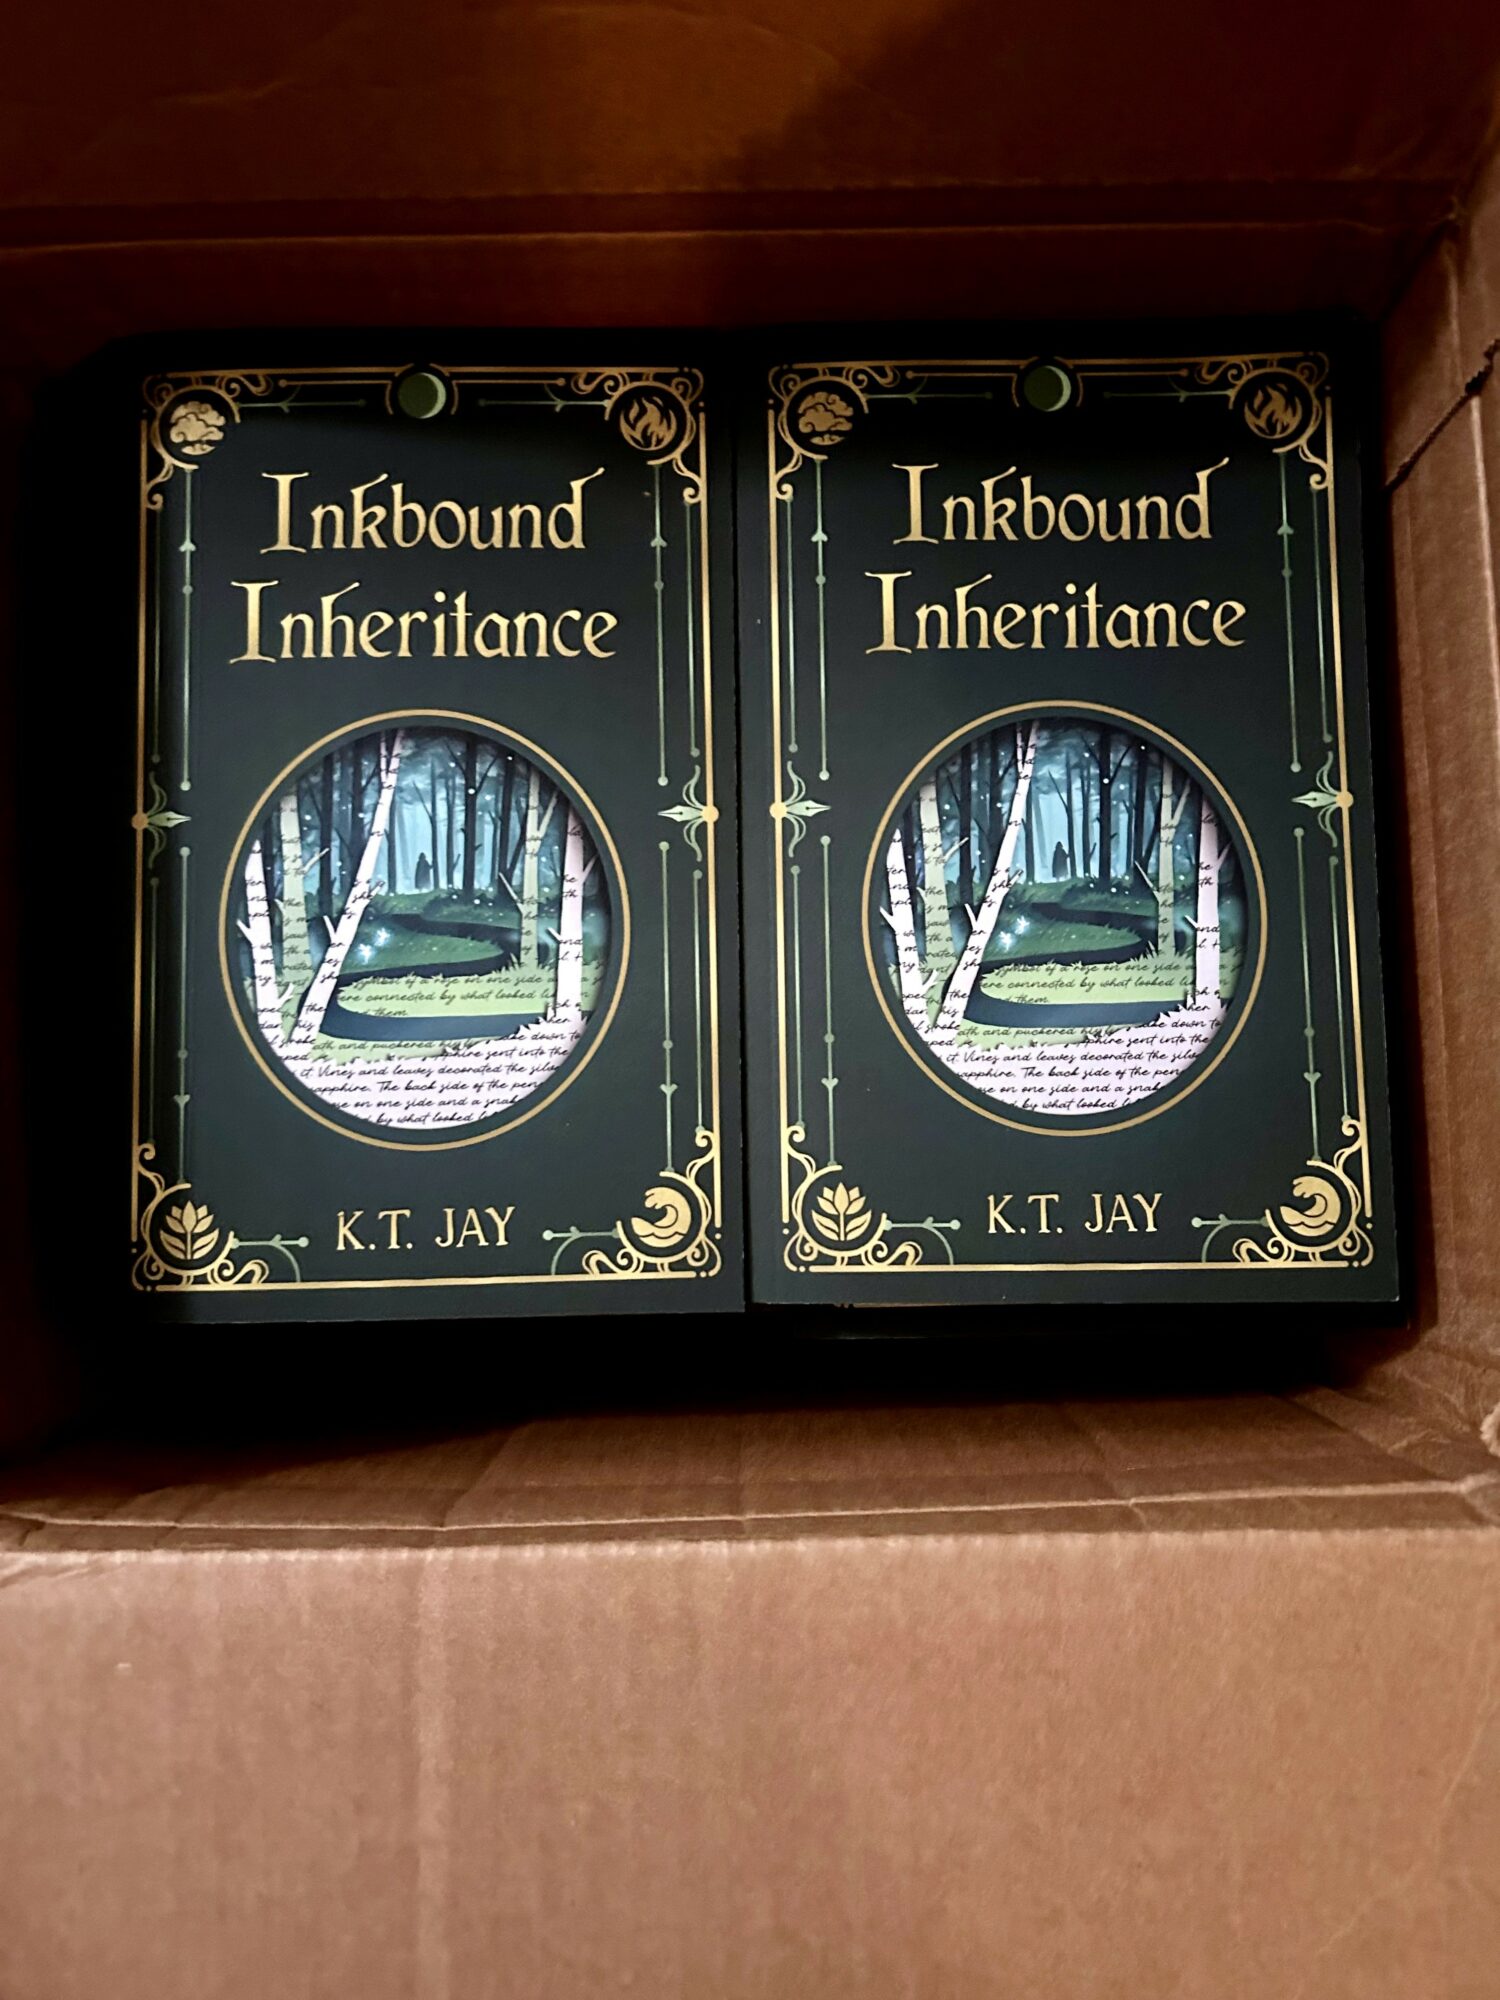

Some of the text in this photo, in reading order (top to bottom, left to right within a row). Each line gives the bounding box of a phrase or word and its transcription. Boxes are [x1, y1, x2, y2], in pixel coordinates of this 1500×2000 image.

[892, 457, 1230, 545] Inkbound
[259, 466, 605, 554] Inkbound
[864, 570, 1248, 655] Inheritance
[228, 579, 618, 665] Inheritance
[1104, 964, 1120, 972] on
[1125, 963, 1148, 972] one
[464, 977, 482, 985] on
[486, 976, 510, 985] one
[1007, 978, 1075, 990] connected
[1080, 976, 1096, 993] by
[1101, 979, 1130, 989] what
[1134, 976, 1174, 988] looked
[366, 990, 435, 1003] connected
[440, 989, 456, 1006] by
[460, 990, 493, 1001] what
[495, 988, 537, 1000] looked
[1171, 1019, 1207, 1029] down
[531, 1032, 567, 1042] down
[983, 1027, 1012, 1037] and
[1014, 1026, 1076, 1040] puckered
[1160, 1034, 1188, 1046] into
[1190, 1034, 1209, 1046] the
[338, 1041, 368, 1051] and
[519, 1046, 547, 1059] into
[549, 1046, 569, 1058] the
[964, 1049, 1000, 1065] Vines
[1003, 1051, 1032, 1062] and
[1036, 1050, 1076, 1064] leaves
[1081, 1048, 1144, 1062] decorated
[1147, 1049, 1168, 1062] the
[318, 1064, 355, 1080] Vines
[358, 1066, 390, 1076] and
[394, 1064, 434, 1078] leaves
[438, 1061, 502, 1076] decorated
[504, 1062, 527, 1075] the
[1020, 1066, 1045, 1079] The
[1050, 1065, 1080, 1079] back
[1082, 1066, 1112, 1080] side
[1128, 1066, 1151, 1079] the
[376, 1080, 402, 1093] The
[405, 1079, 437, 1093] back
[440, 1080, 471, 1093] side
[486, 1078, 509, 1092] the
[1000, 1086, 1018, 1094] on
[1021, 1085, 1046, 1093] one
[1050, 1083, 1079, 1097] side
[1082, 1083, 1112, 1093] and
[1114, 1085, 1125, 1093] a
[353, 1100, 373, 1109] on
[376, 1100, 402, 1108] one
[404, 1096, 434, 1110] side
[438, 1095, 470, 1106] and
[471, 1098, 482, 1106] a
[1042, 1099, 1072, 1112] what
[1076, 1098, 1117, 1109] looked
[396, 1113, 431, 1126] what
[432, 1111, 474, 1123] looked
[986, 1192, 1163, 1235] K.T. JAY
[335, 1206, 516, 1251] K.T. JAY
